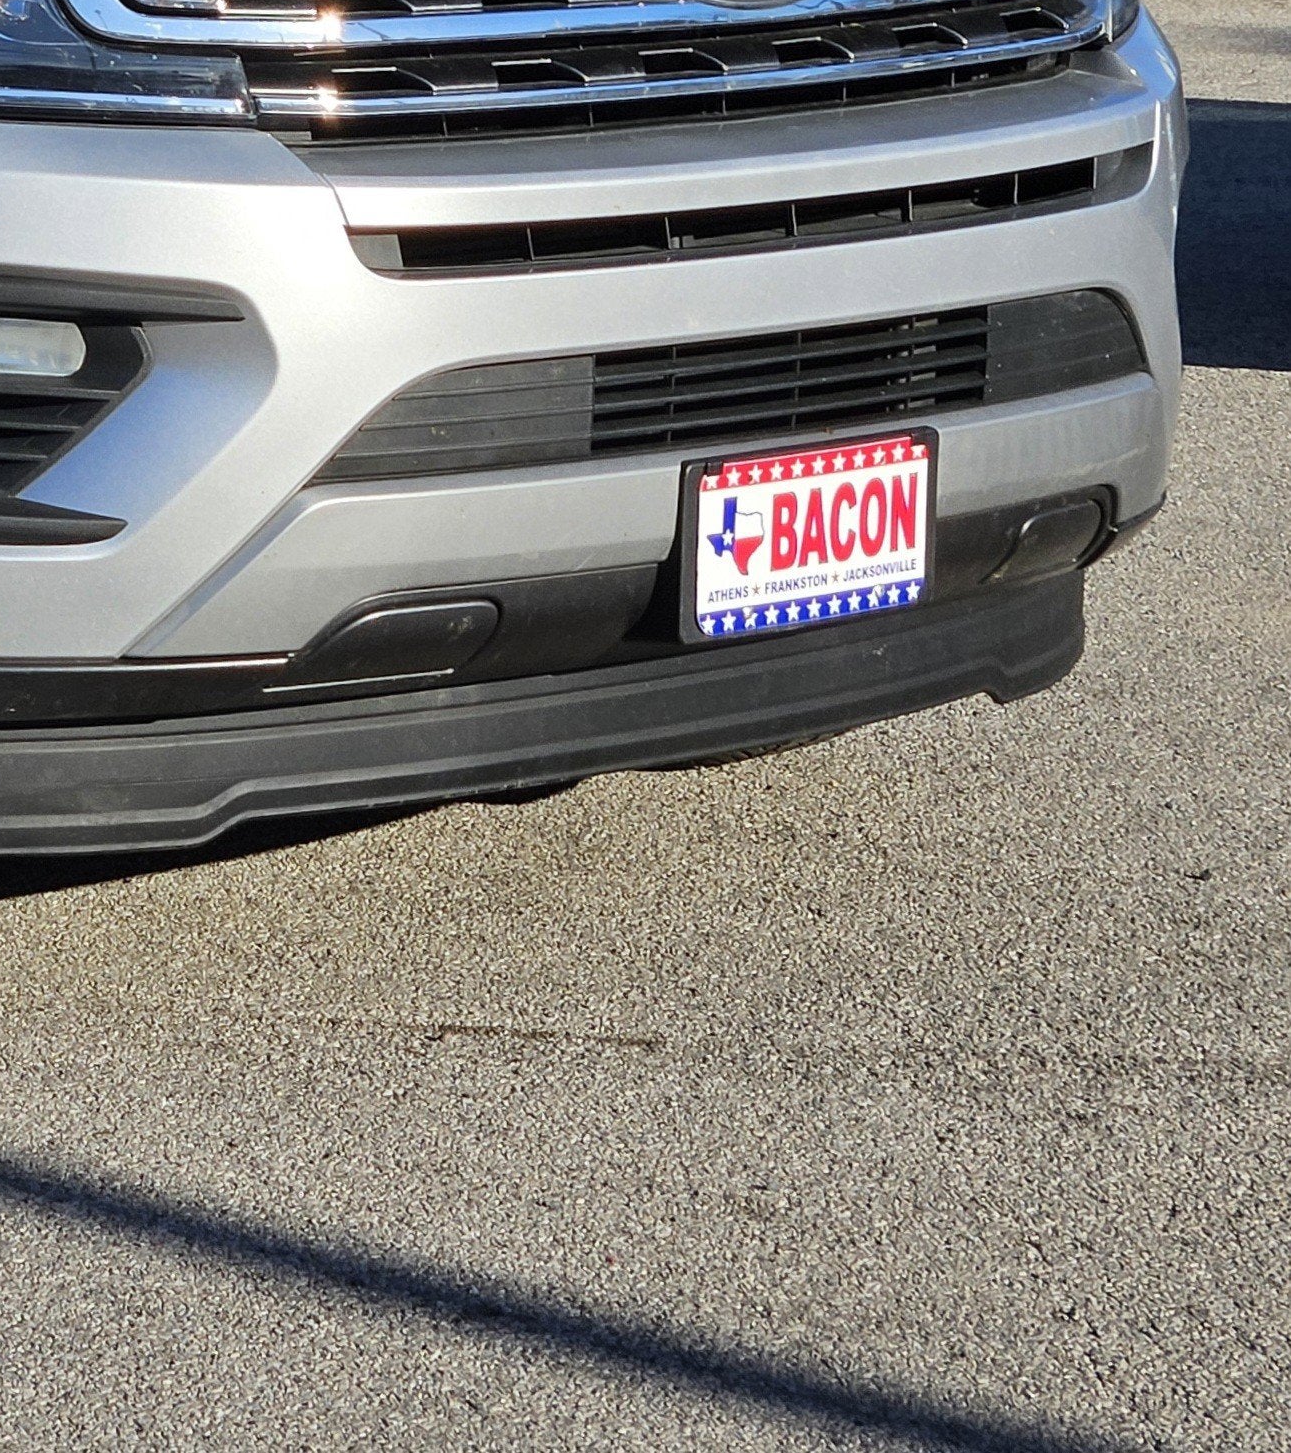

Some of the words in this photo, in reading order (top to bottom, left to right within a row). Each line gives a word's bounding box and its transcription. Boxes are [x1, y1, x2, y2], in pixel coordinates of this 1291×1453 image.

[770, 472, 919, 572] BACON
[707, 585, 749, 604] ATHENS
[764, 573, 829, 595] FRANKSTON
[842, 558, 918, 583] JACKSONVILLE
